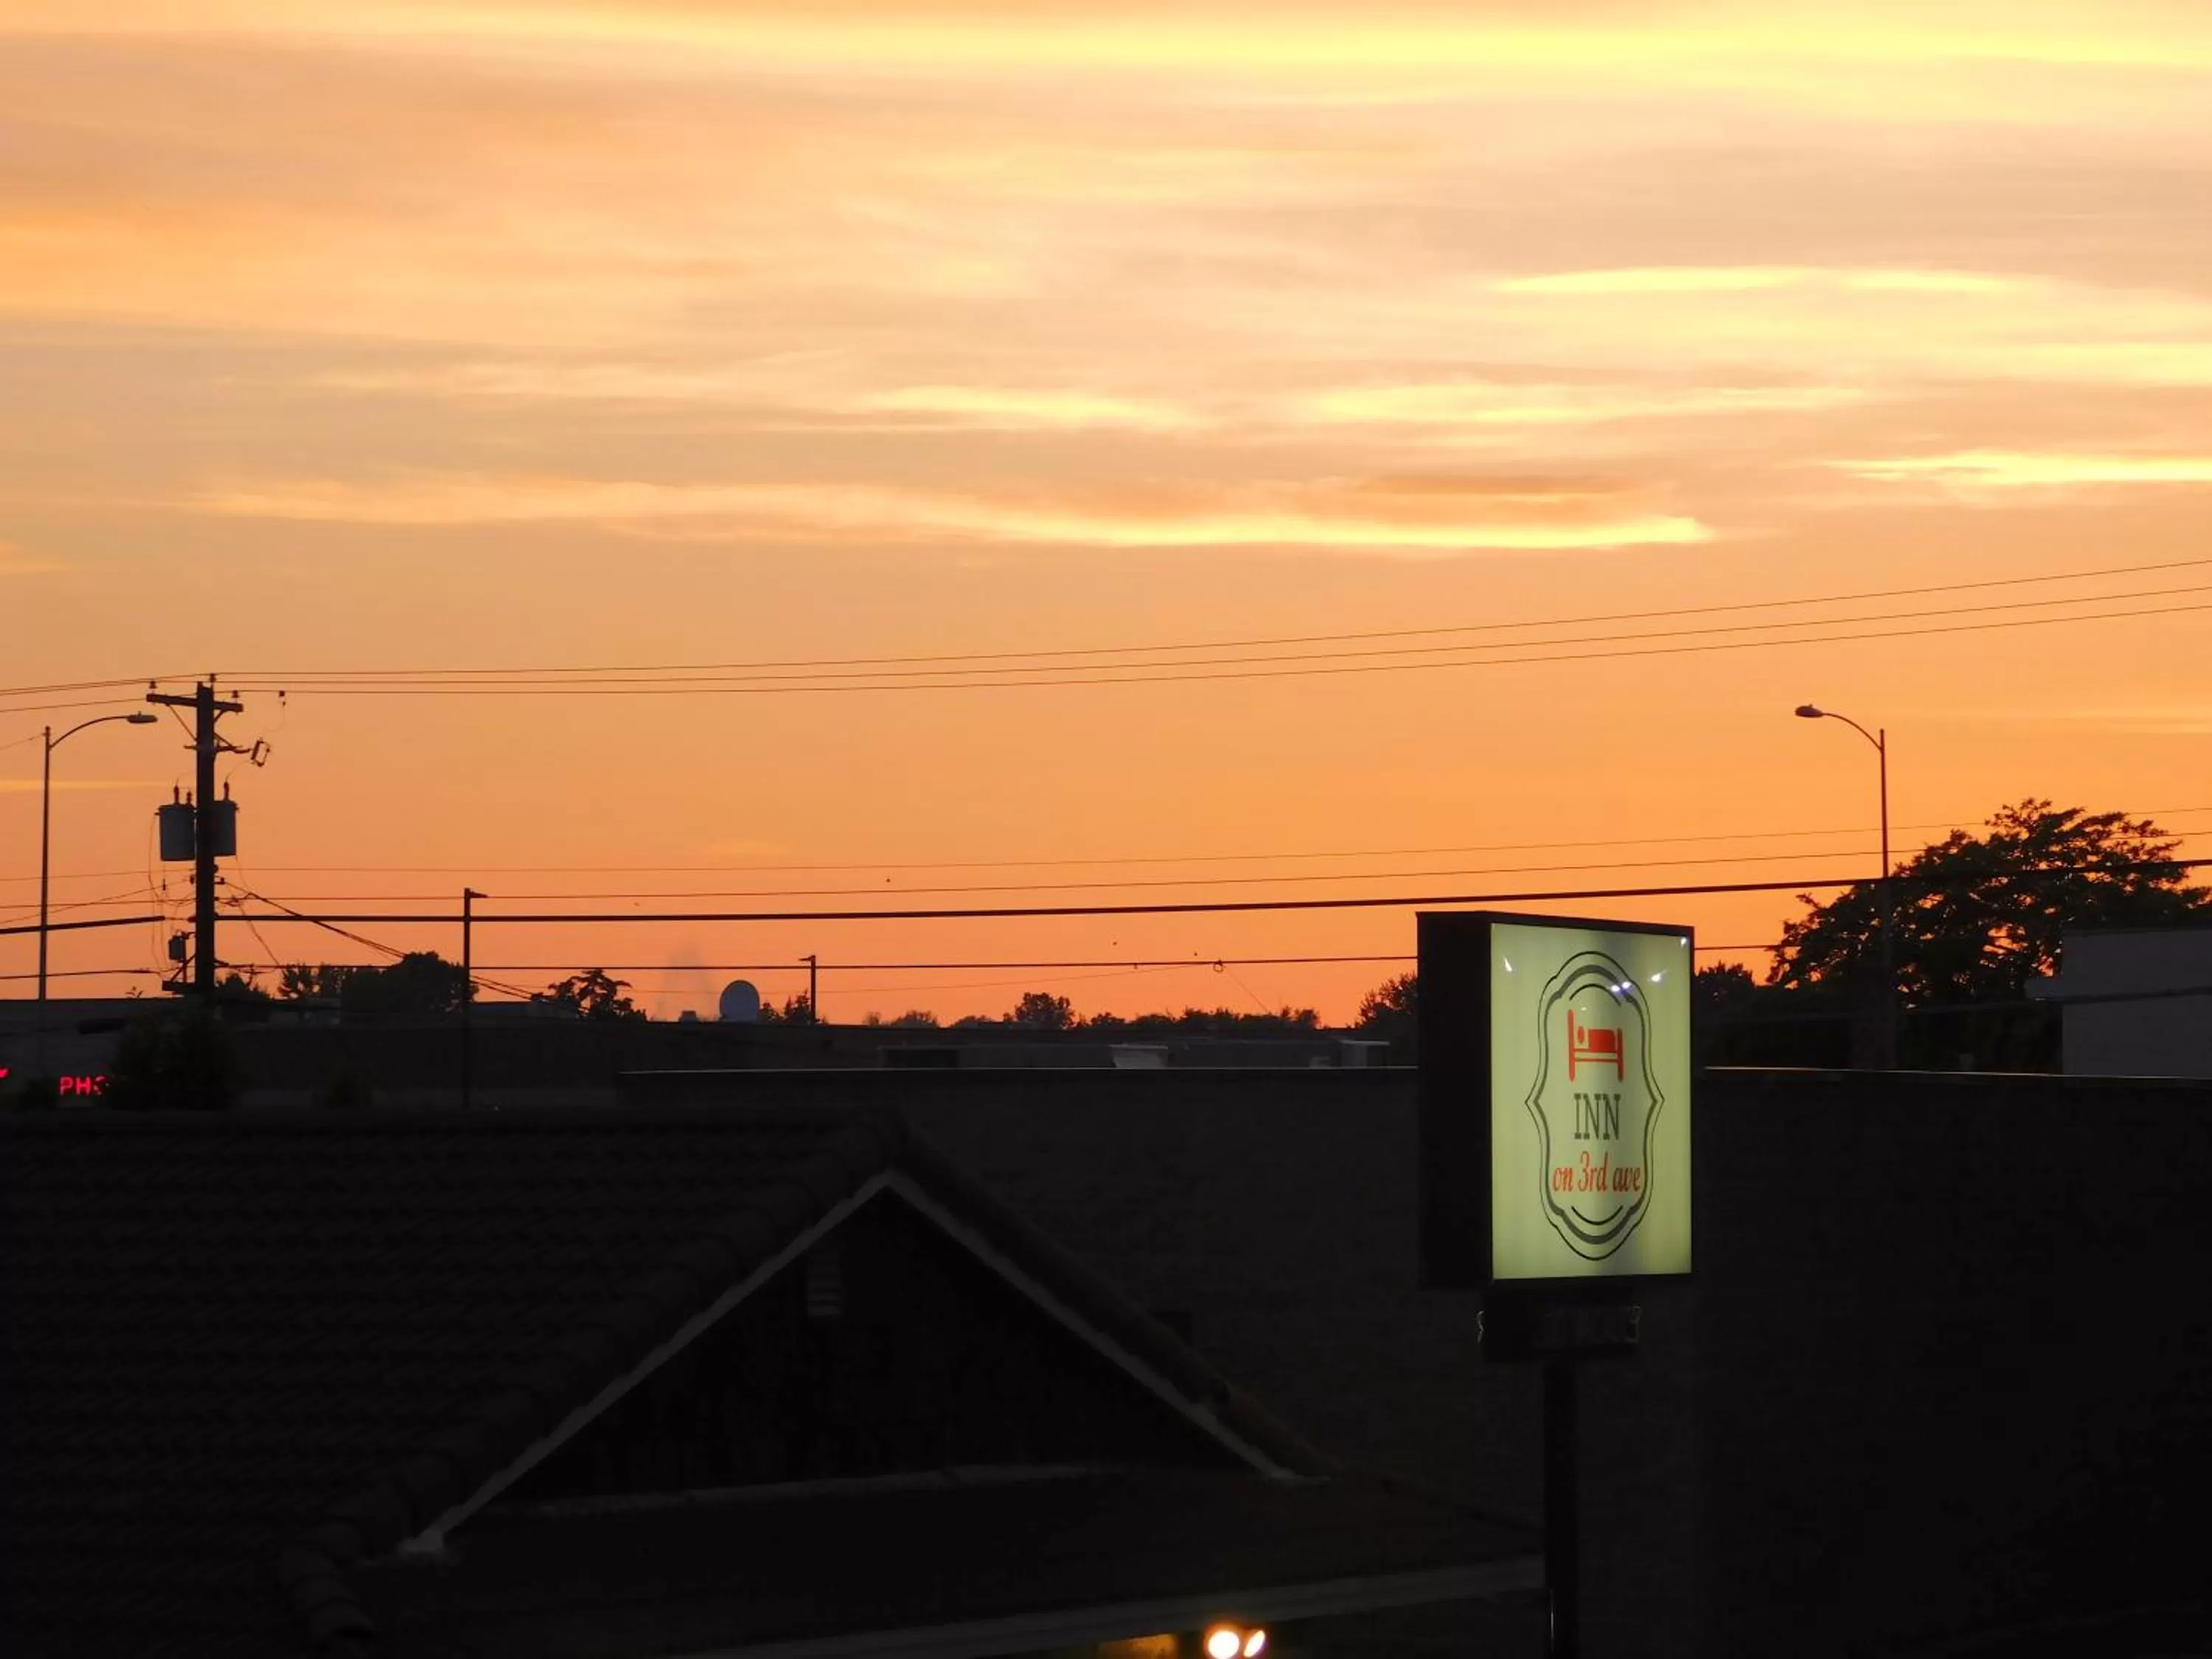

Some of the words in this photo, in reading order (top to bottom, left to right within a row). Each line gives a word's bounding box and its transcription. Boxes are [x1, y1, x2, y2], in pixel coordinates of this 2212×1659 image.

[1574, 1093, 1621, 1139] INN
[1553, 1167, 1573, 1192] on
[1578, 1150, 1608, 1192] 3rd
[1613, 1167, 1641, 1192] ave
